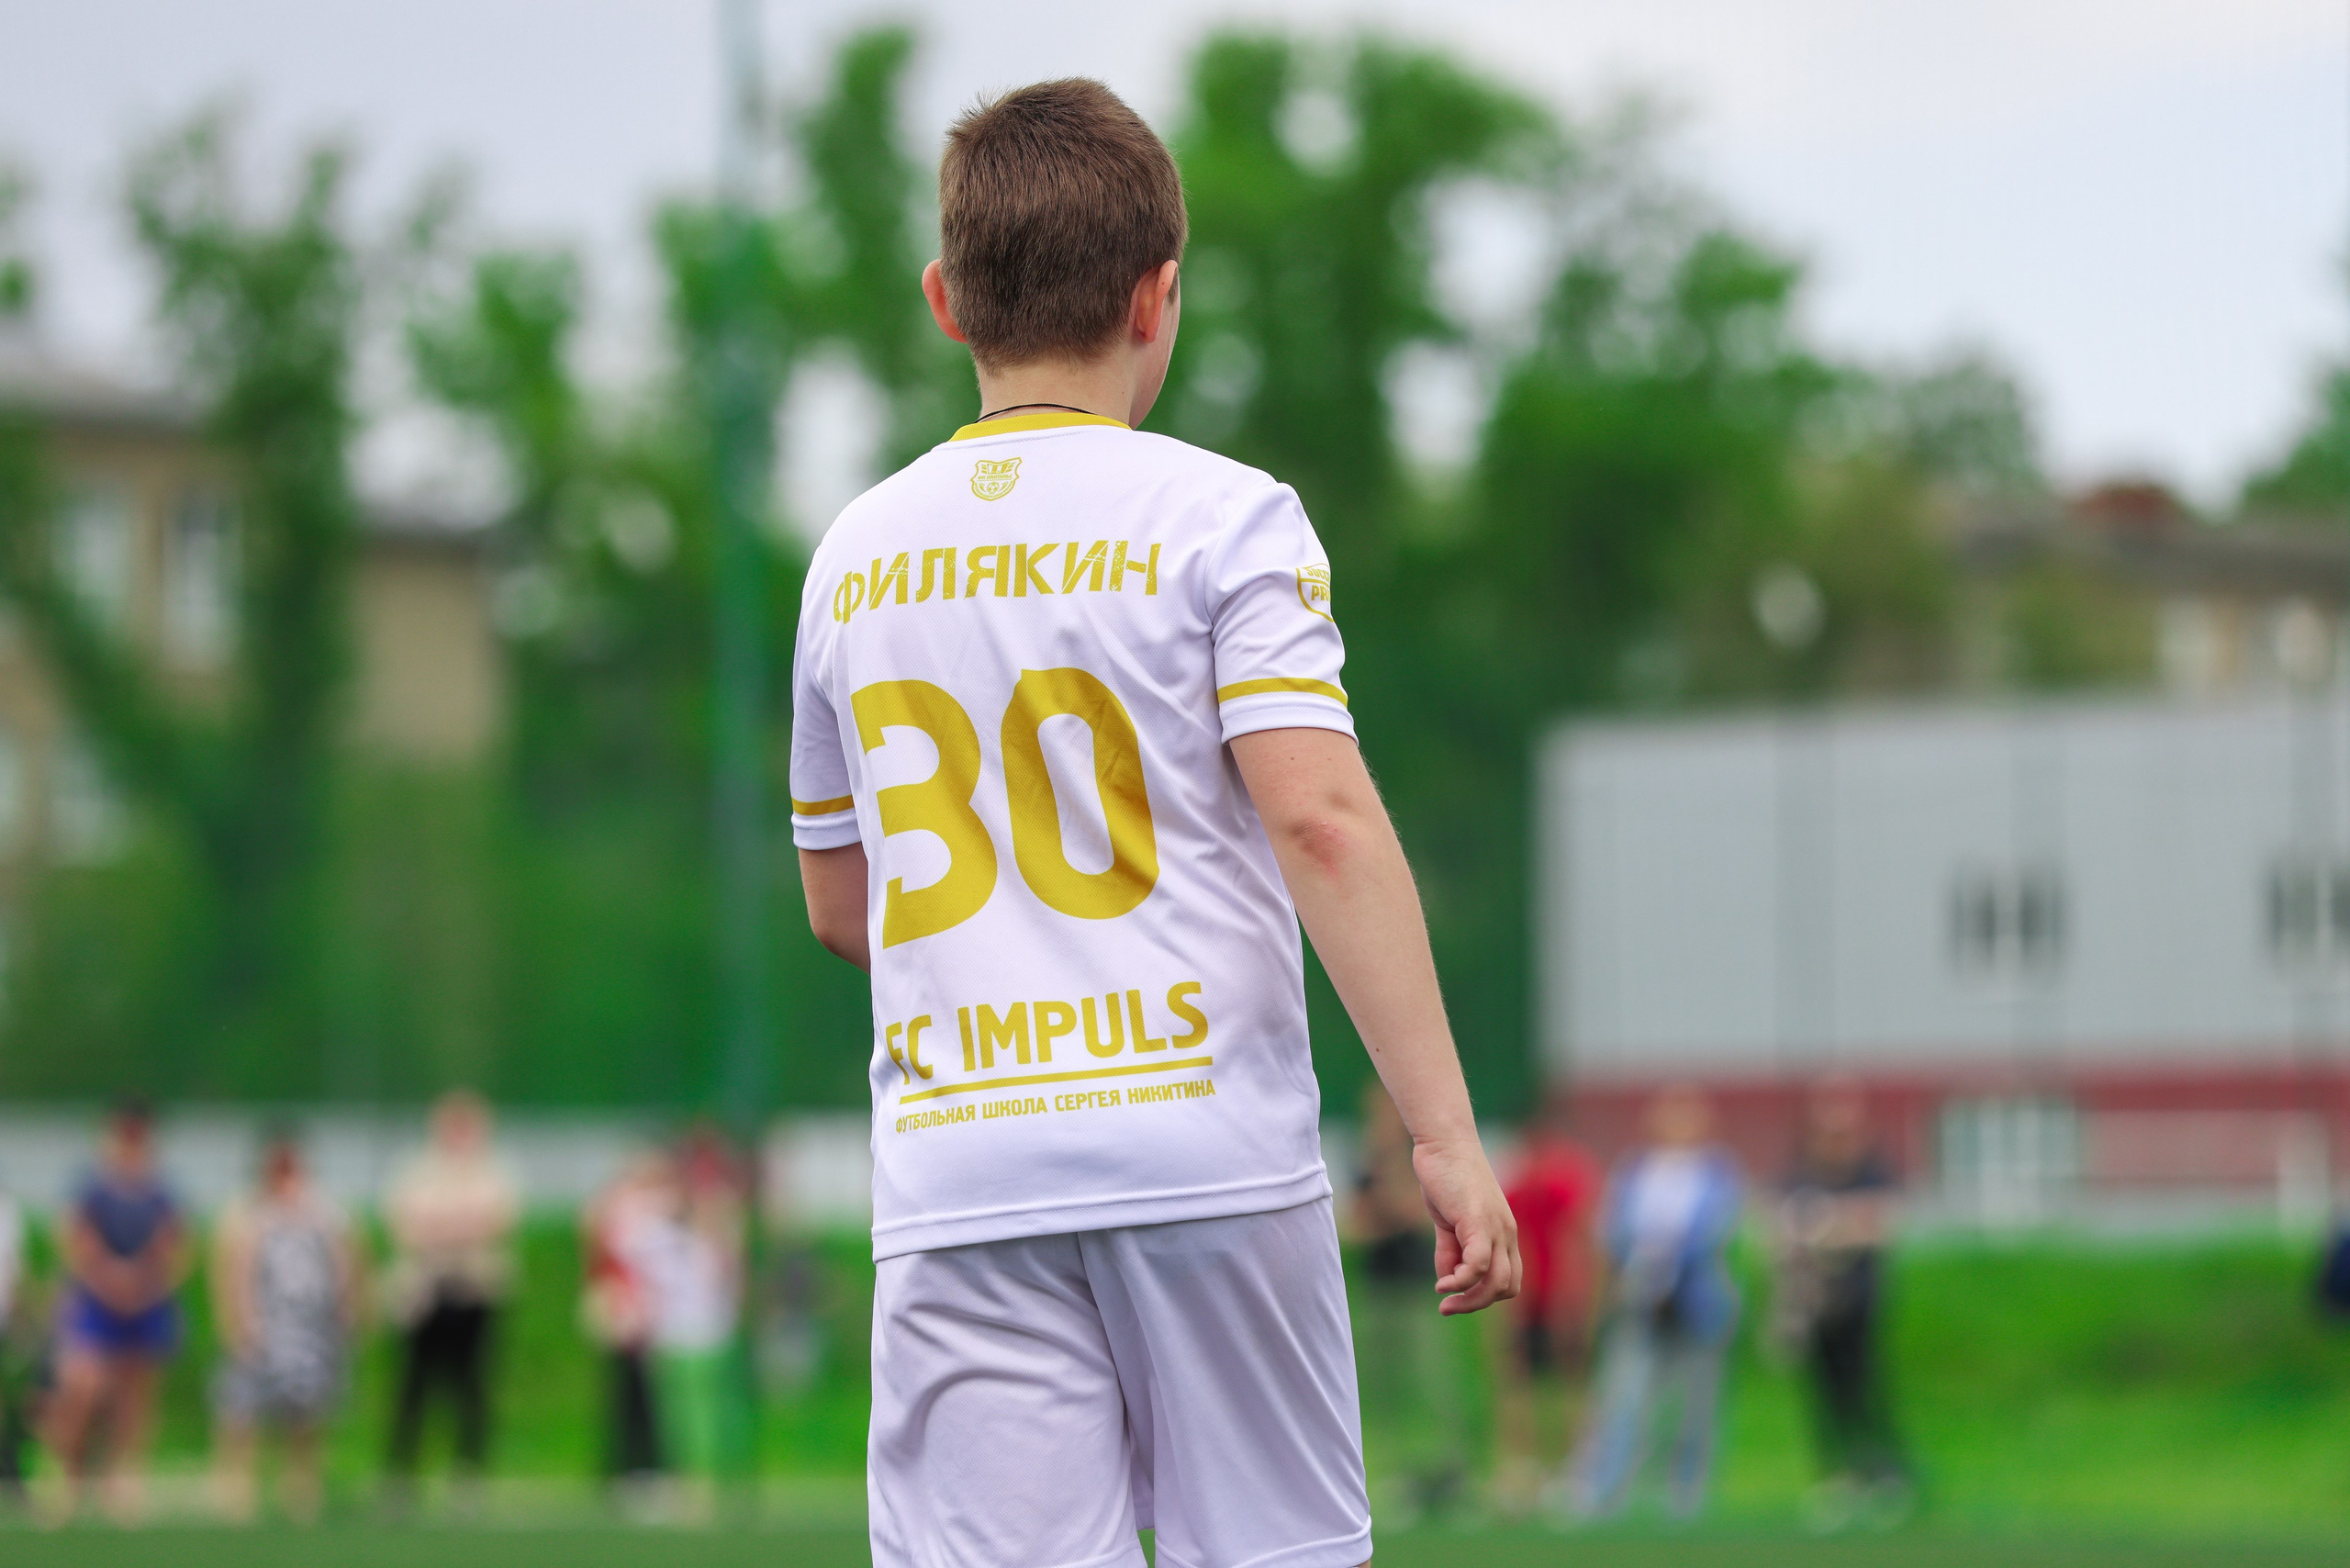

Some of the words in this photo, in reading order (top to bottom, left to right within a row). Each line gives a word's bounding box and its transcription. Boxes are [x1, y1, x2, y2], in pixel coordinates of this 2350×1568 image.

[833, 540, 1161, 624] ФИЛЯКИН
[1311, 585, 1330, 601] PR
[850, 666, 1160, 949] 30
[885, 1014, 933, 1085] FC
[957, 980, 1209, 1072] IMPULS
[895, 1104, 976, 1134] ФУТБОЛЬНАЯ
[982, 1097, 1047, 1119] ШКОЛА
[1055, 1090, 1121, 1112] СЕРГЕЯ
[1127, 1079, 1216, 1104] НИКИТИНА
